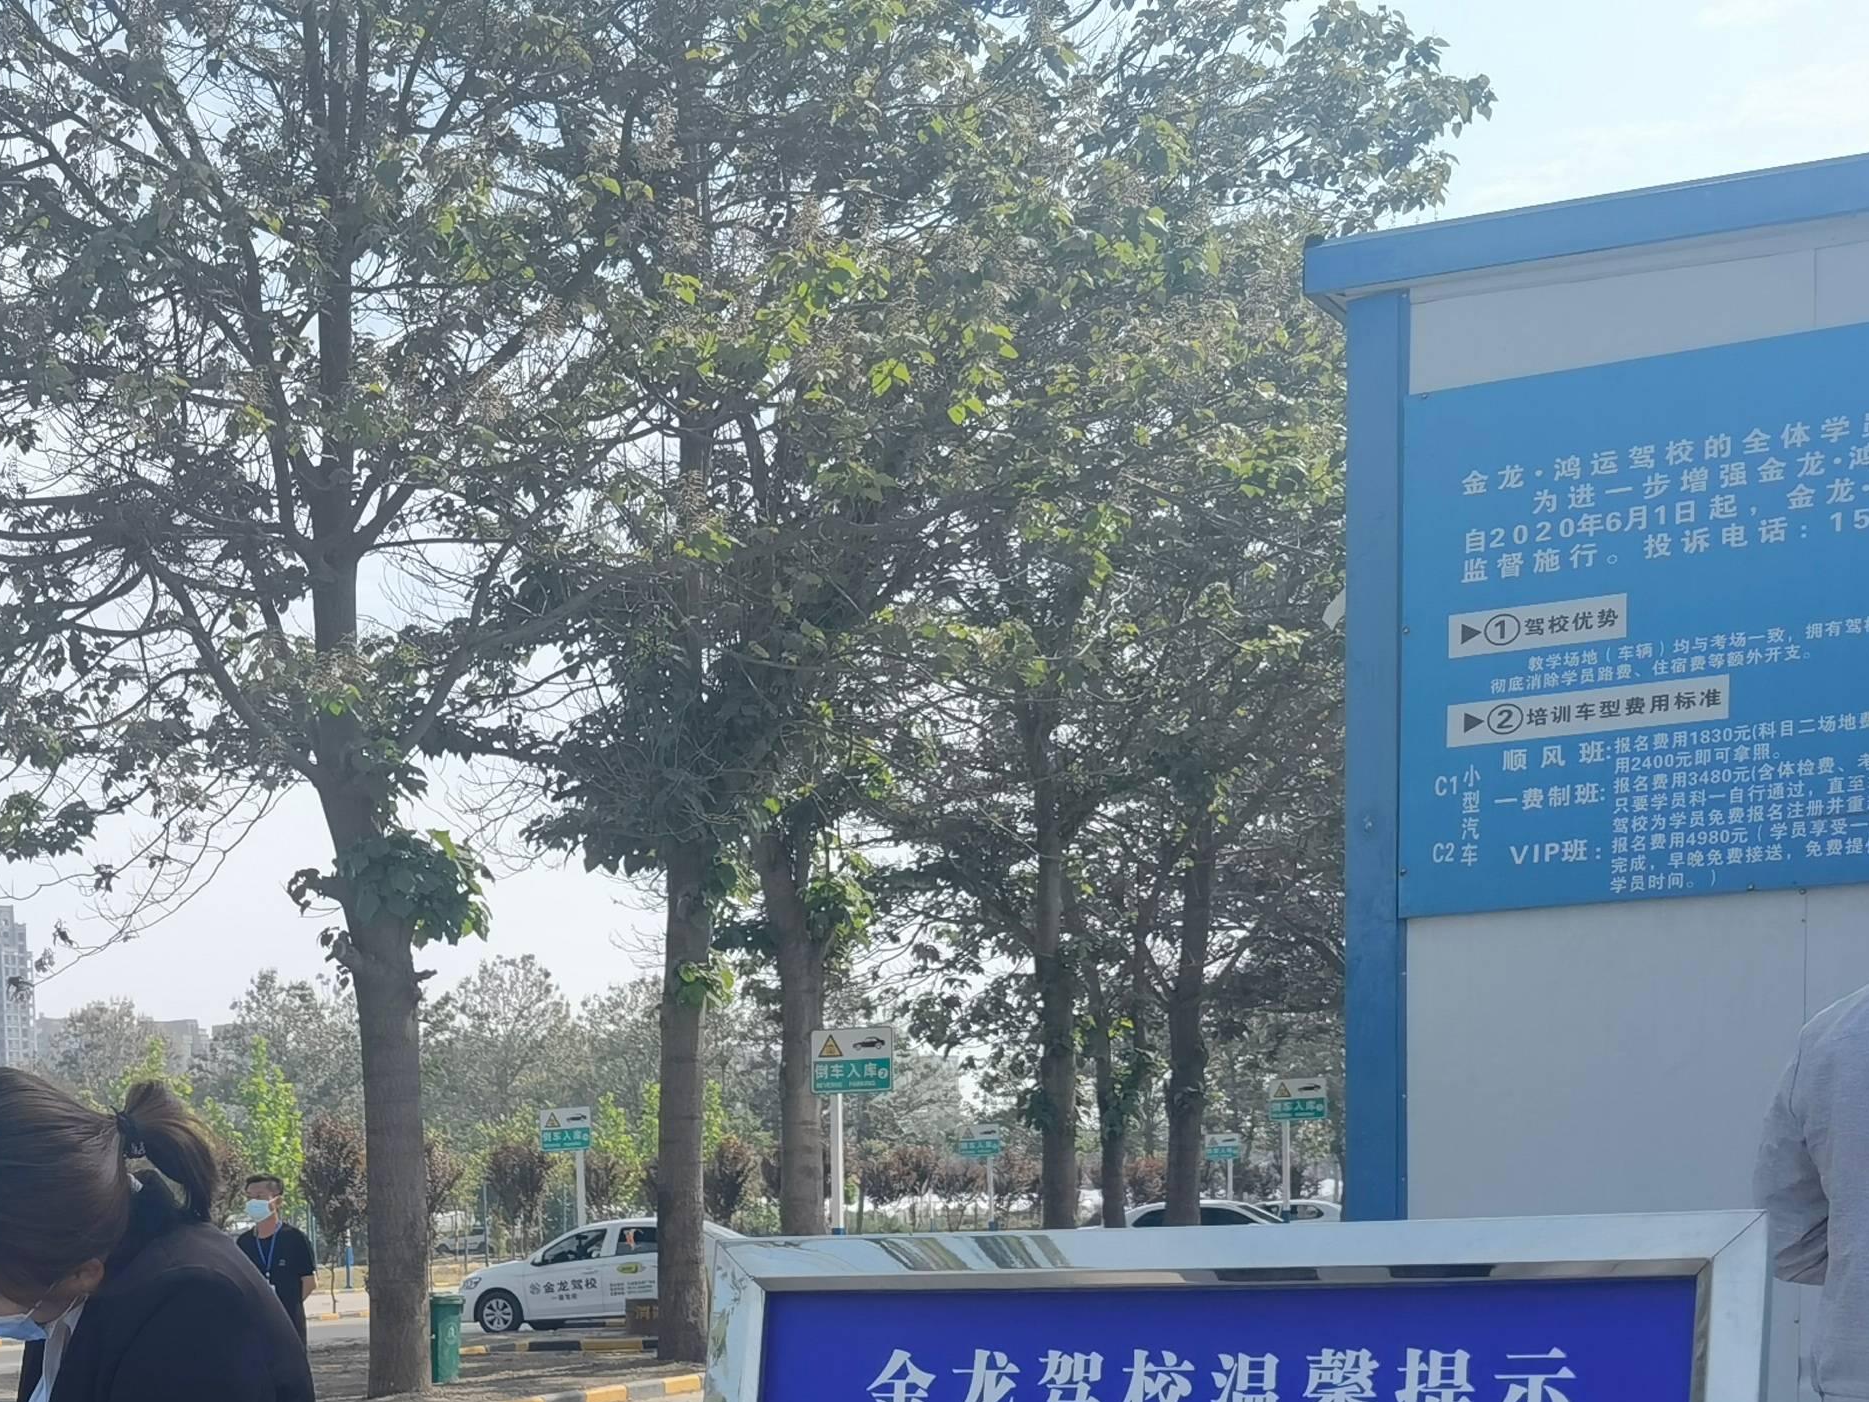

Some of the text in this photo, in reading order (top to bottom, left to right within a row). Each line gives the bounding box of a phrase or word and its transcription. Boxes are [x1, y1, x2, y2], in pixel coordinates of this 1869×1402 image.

[1462, 413, 1869, 495] 金龙·鸿运驾校的全体学
[1612, 795, 1869, 834] 驾校为学员免费报名注册并重
[1613, 775, 1869, 815] 只要学员科一自行通过，直至
[1610, 837, 1869, 874] 完成，早晚免费接送，免费提
